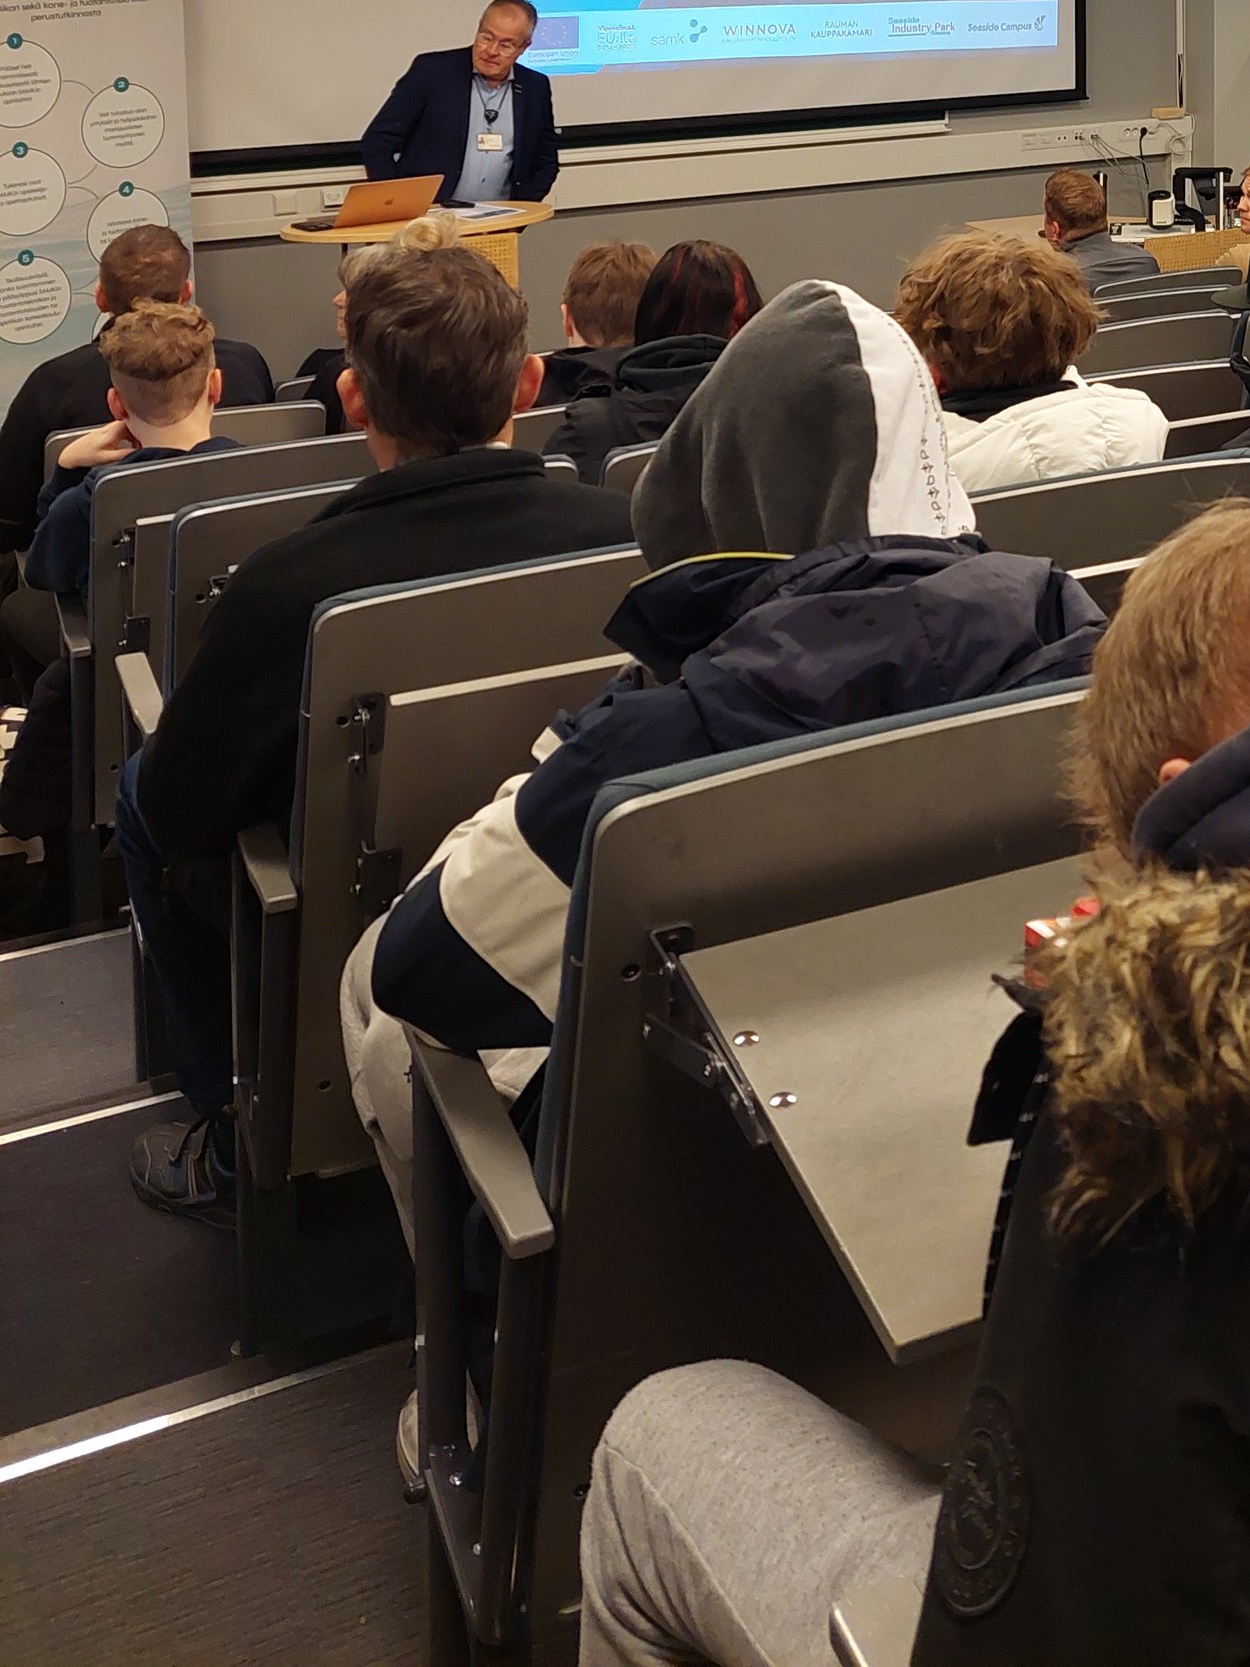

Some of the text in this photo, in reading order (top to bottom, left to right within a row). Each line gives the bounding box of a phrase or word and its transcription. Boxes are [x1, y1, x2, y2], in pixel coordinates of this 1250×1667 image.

[22, 1, 42, 12] sekä
[43, 0, 68, 10] kone-
[824, 20, 859, 29] RAUMAN
[888, 16, 920, 25] Seaside
[723, 23, 796, 36] WINNOVA
[891, 22, 956, 35] Industry Park
[967, 22, 1032, 33] Seaside Campus
[810, 29, 873, 39] KAUPPAKAMARI
[650, 33, 685, 46] samk
[117, 80, 125, 88] 2
[16, 146, 24, 155] 3
[122, 185, 130, 194] 4
